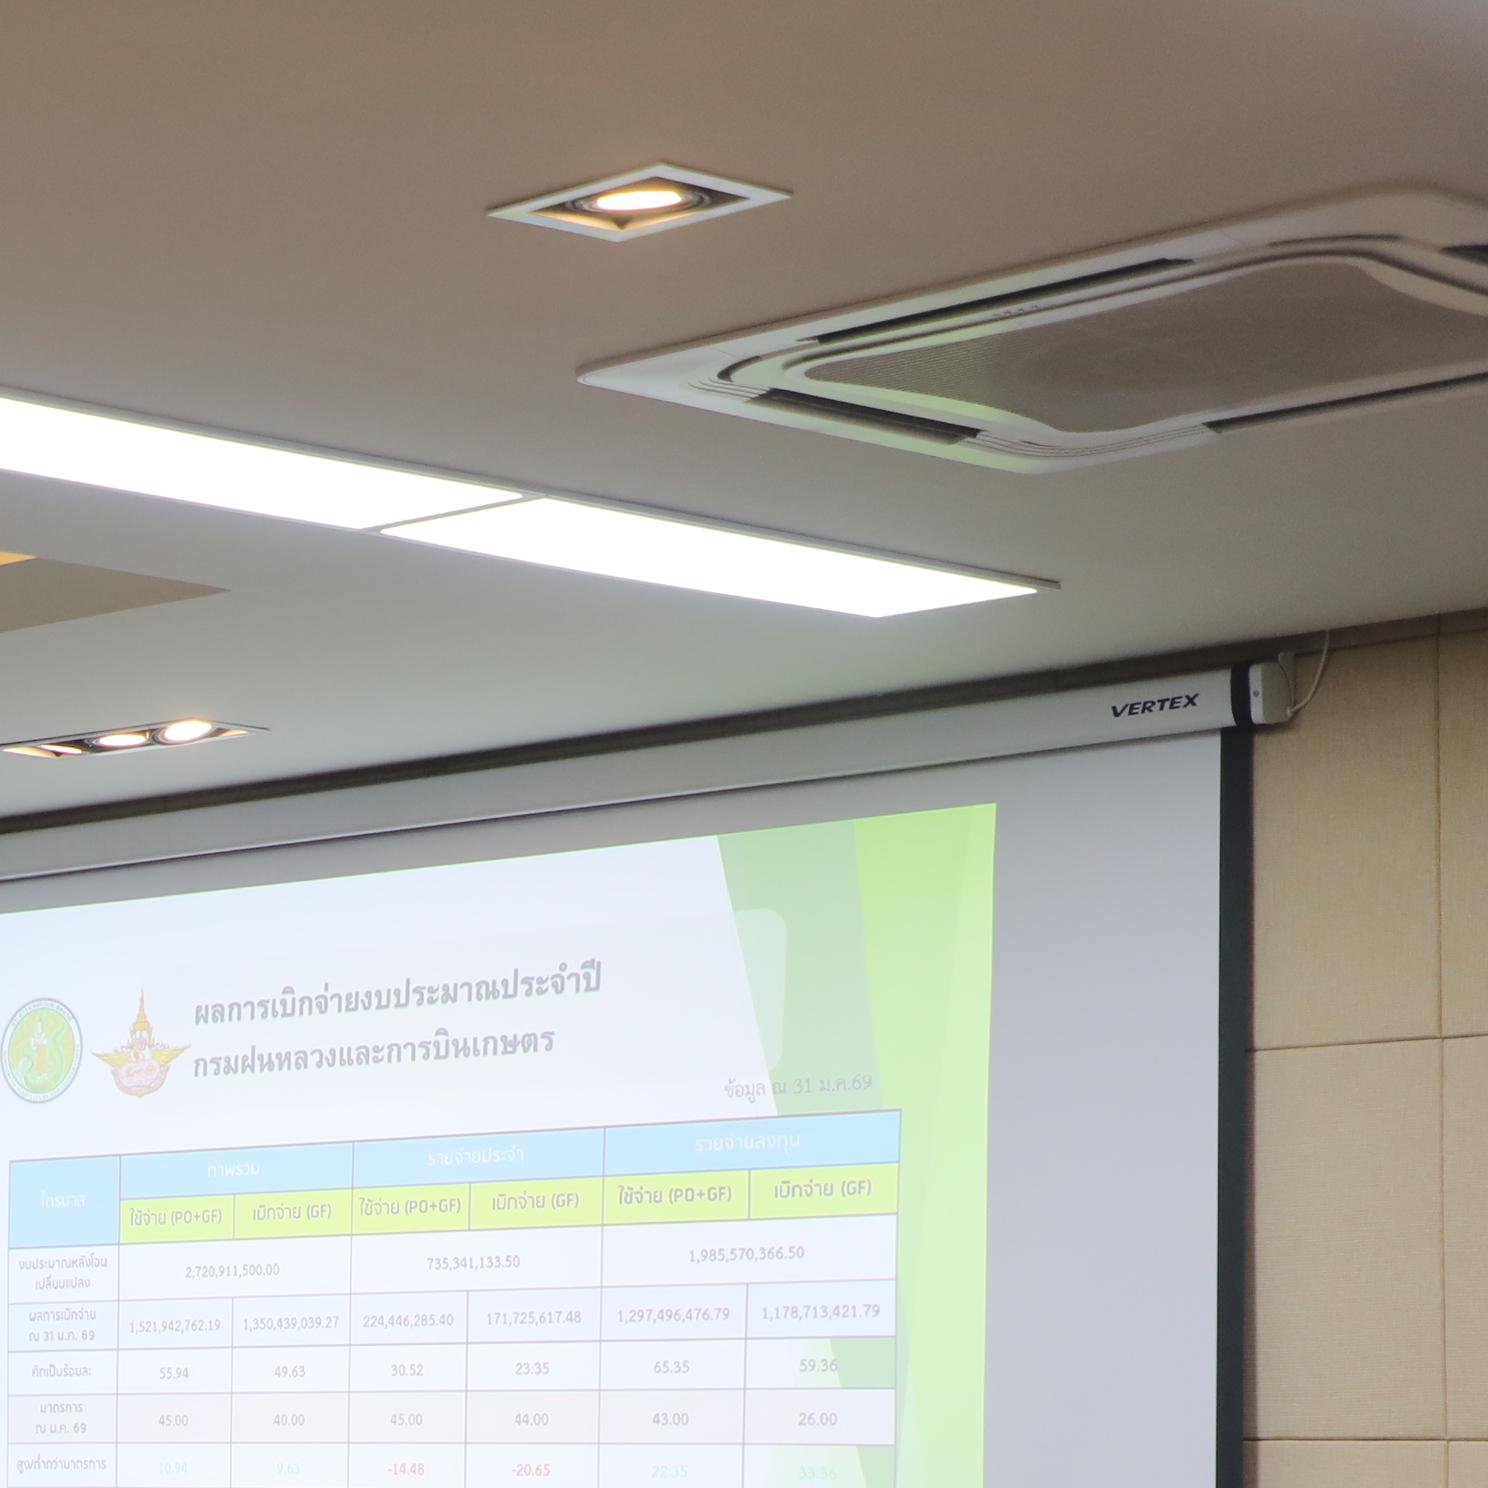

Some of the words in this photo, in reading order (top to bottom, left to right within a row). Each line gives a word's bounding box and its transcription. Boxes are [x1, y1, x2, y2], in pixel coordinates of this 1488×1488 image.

[1111, 693, 1200, 718] VERTEX
[194, 958, 603, 1026] ผลการเบิกจ่ายงบประมาณประจำปี
[193, 1028, 555, 1079] กรมฝนหลวงและการบินเกษตร
[724, 1077, 766, 1104] ข้อมูล
[772, 1081, 787, 1096] ณ
[793, 1077, 812, 1095] 31
[819, 1073, 873, 1093] ม.ค.69
[694, 1131, 802, 1154] รายจ่ายลงทุน
[427, 1144, 526, 1168] รายจ่ายประจำ
[207, 1161, 261, 1179] ภาพรวม
[617, 1183, 664, 1207] ใช้จ่าย
[668, 1184, 733, 1206] (PO+GF)
[773, 1175, 835, 1201] เบิกจ่าย
[840, 1178, 873, 1198] (GF)
[40, 1189, 87, 1210] ไตรมาส
[358, 1196, 401, 1218] ใช้จ่าย
[404, 1197, 462, 1217] (PO+GF)
[491, 1189, 548, 1212] เบิกจ่าย
[550, 1190, 580, 1211] (GF)
[129, 1207, 167, 1227] ใช้จ่าย
[170, 1208, 223, 1227] (PO+GF)
[252, 1202, 302, 1223] เบิกจ่าย
[305, 1202, 333, 1221] (GF)
[18, 1254, 108, 1272] งบประมาณหลังโอน
[426, 1253, 522, 1273] 735,341,133.50
[688, 1244, 806, 1265] 1,985,570,366.50
[184, 1262, 281, 1280] 2,720,911,500.00
[35, 1273, 91, 1293] เปลี่ยนแปลง
[28, 1306, 97, 1323] ผลการเบิกจ่าย
[362, 1312, 454, 1329] 224,446,285.40
[486, 1310, 582, 1327] 171,725,617.48
[617, 1306, 731, 1325] 1,297,496,476.79
[761, 1303, 881, 1322] 1,178,713,421.79
[129, 1318, 222, 1335] 1,521,942,762.19
[242, 1315, 340, 1332] 1,350,439,039.27
[28, 1331, 41, 1343] ณ
[43, 1330, 55, 1342] 31
[57, 1329, 79, 1343] ม.ค.
[81, 1328, 96, 1342] 69
[31, 1362, 93, 1380] คิดเป็นร้อยละ
[158, 1365, 190, 1381] 55.94
[273, 1364, 307, 1379] 49.63
[390, 1363, 425, 1378] 30.52
[514, 1360, 550, 1376] 23.35
[653, 1359, 691, 1376] 65.35
[798, 1357, 839, 1374] 59.36
[39, 1401, 84, 1415] มาตรการ
[158, 1414, 189, 1428] 45.00
[273, 1413, 306, 1428] 40.00
[389, 1413, 424, 1427] 45.00
[514, 1412, 550, 1427] 44.00
[651, 1412, 690, 1428] 43.00
[798, 1412, 839, 1428] 26.00
[35, 1423, 47, 1435] ณ
[49, 1422, 70, 1435] ม.ค.
[72, 1422, 87, 1435] 69
[16, 1452, 107, 1474] สูง/ต่ำกว่ามาตรการ
[158, 1461, 189, 1475] 10.94
[276, 1462, 301, 1476] 9.63
[386, 1463, 426, 1477] -14.48
[510, 1462, 552, 1478] -20.65
[651, 1464, 688, 1480] 22.35
[798, 1465, 839, 1482] 33.36
